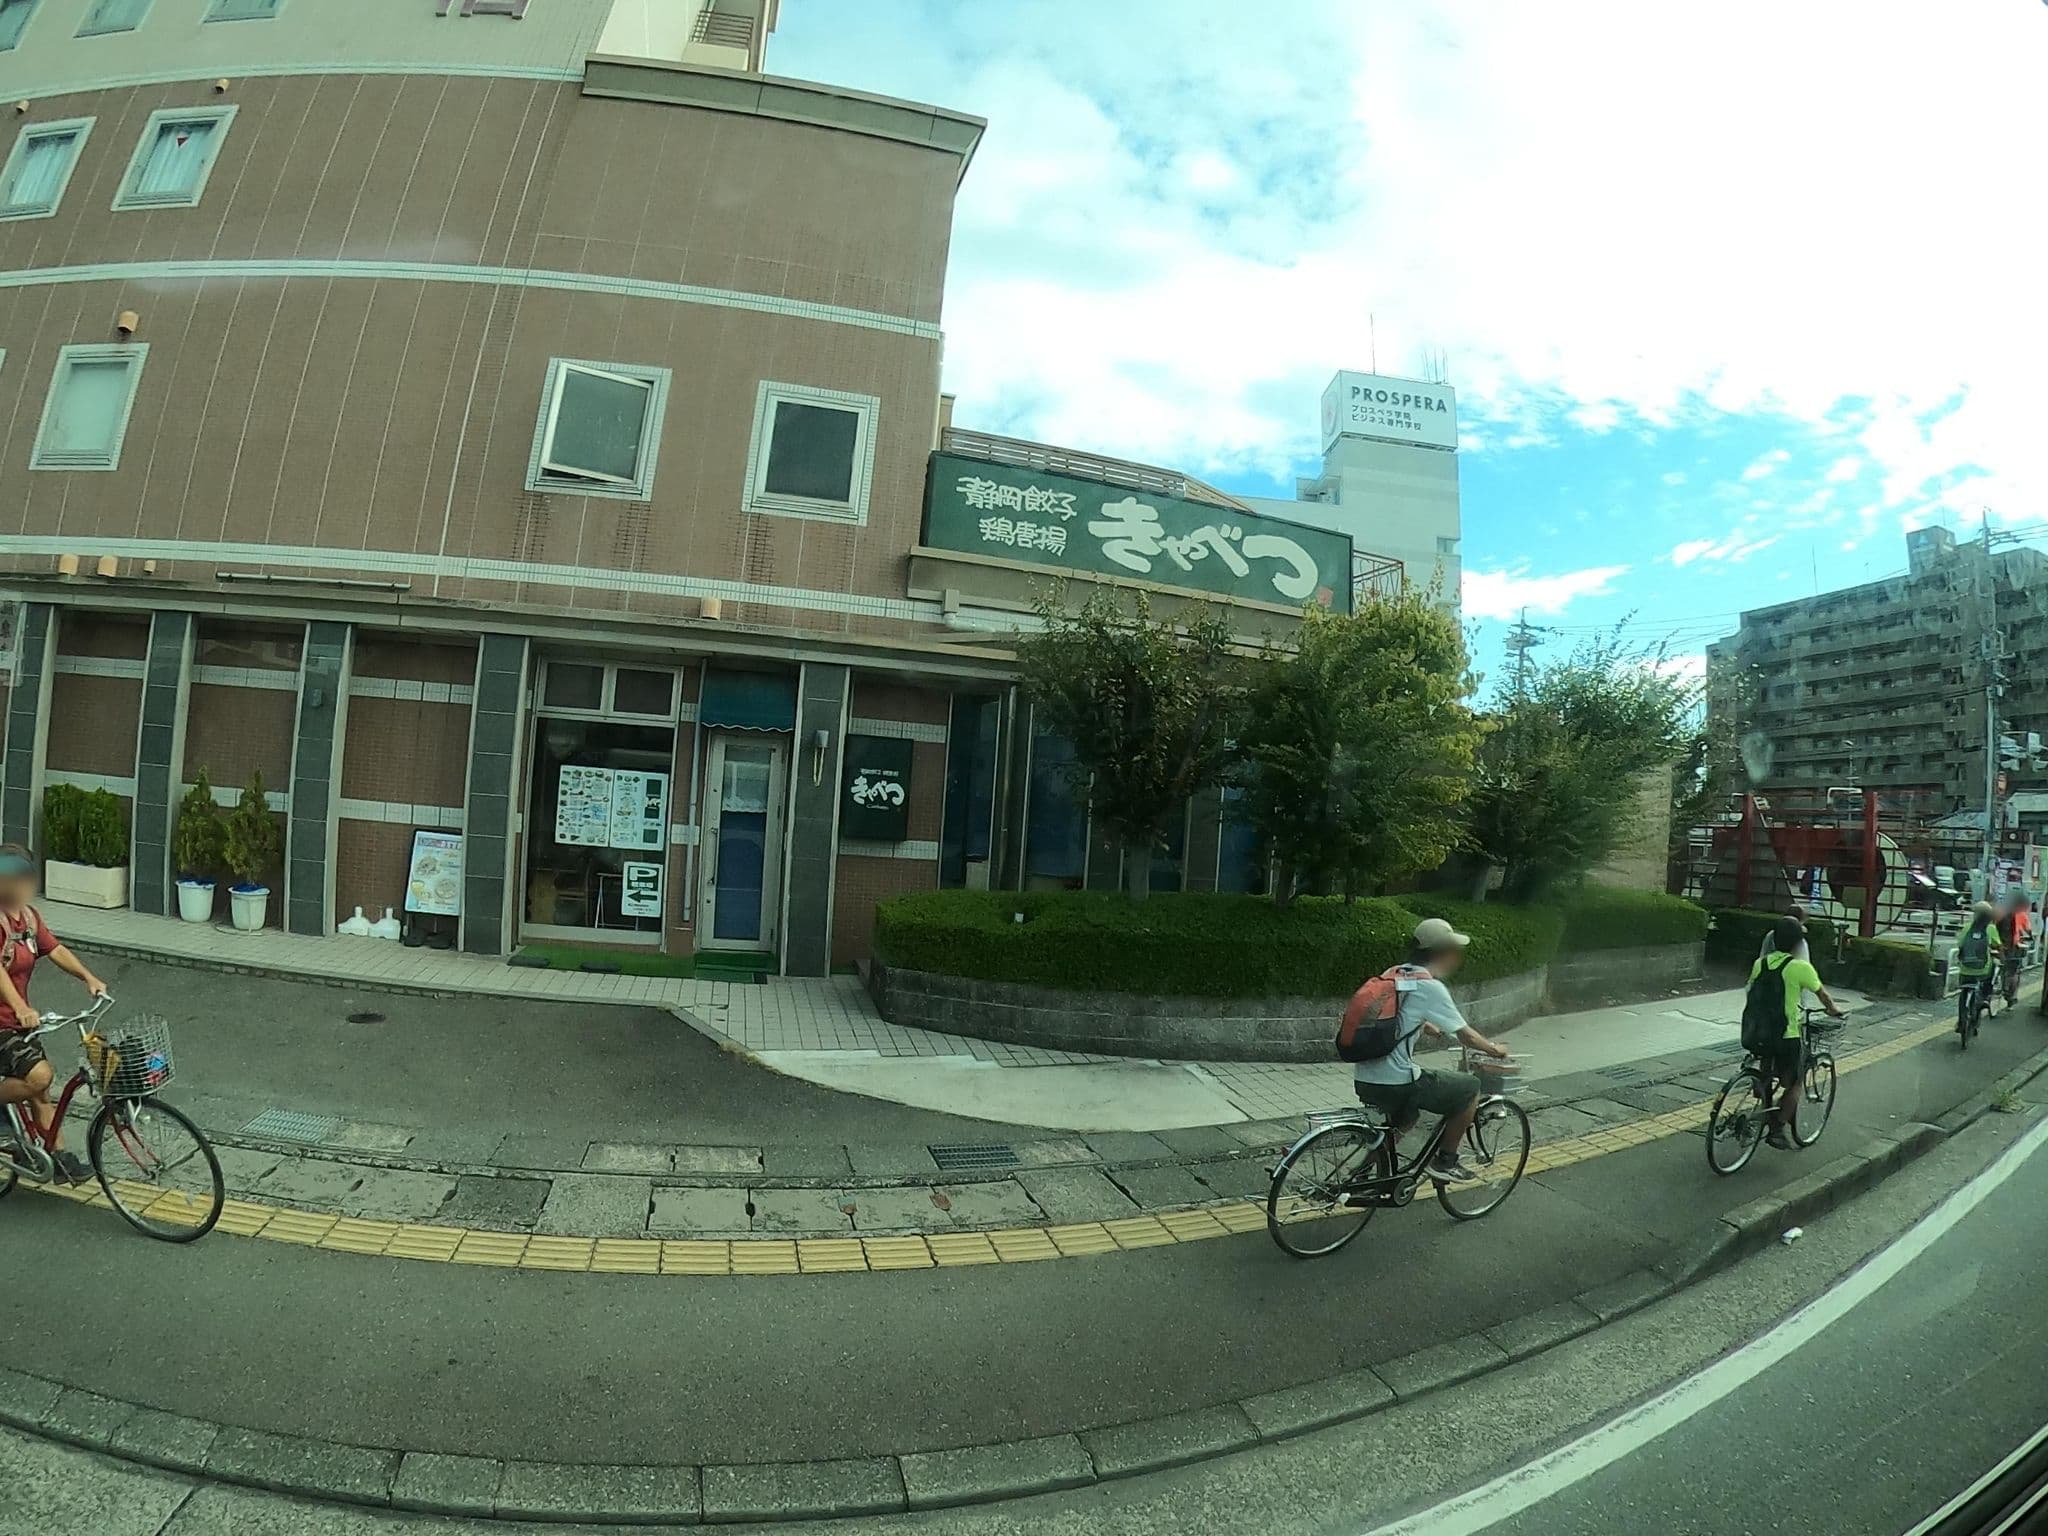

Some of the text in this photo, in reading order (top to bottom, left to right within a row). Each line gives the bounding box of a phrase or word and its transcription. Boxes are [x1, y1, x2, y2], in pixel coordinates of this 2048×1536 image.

[1351, 386, 1447, 412] PROSPERA
[956, 476, 1078, 521] 静岡餃子
[978, 516, 1068, 557] 鶏唐揚
[1087, 496, 1318, 599] きゃべつ
[850, 775, 905, 806] きゃべつ
[629, 866, 658, 881] P
